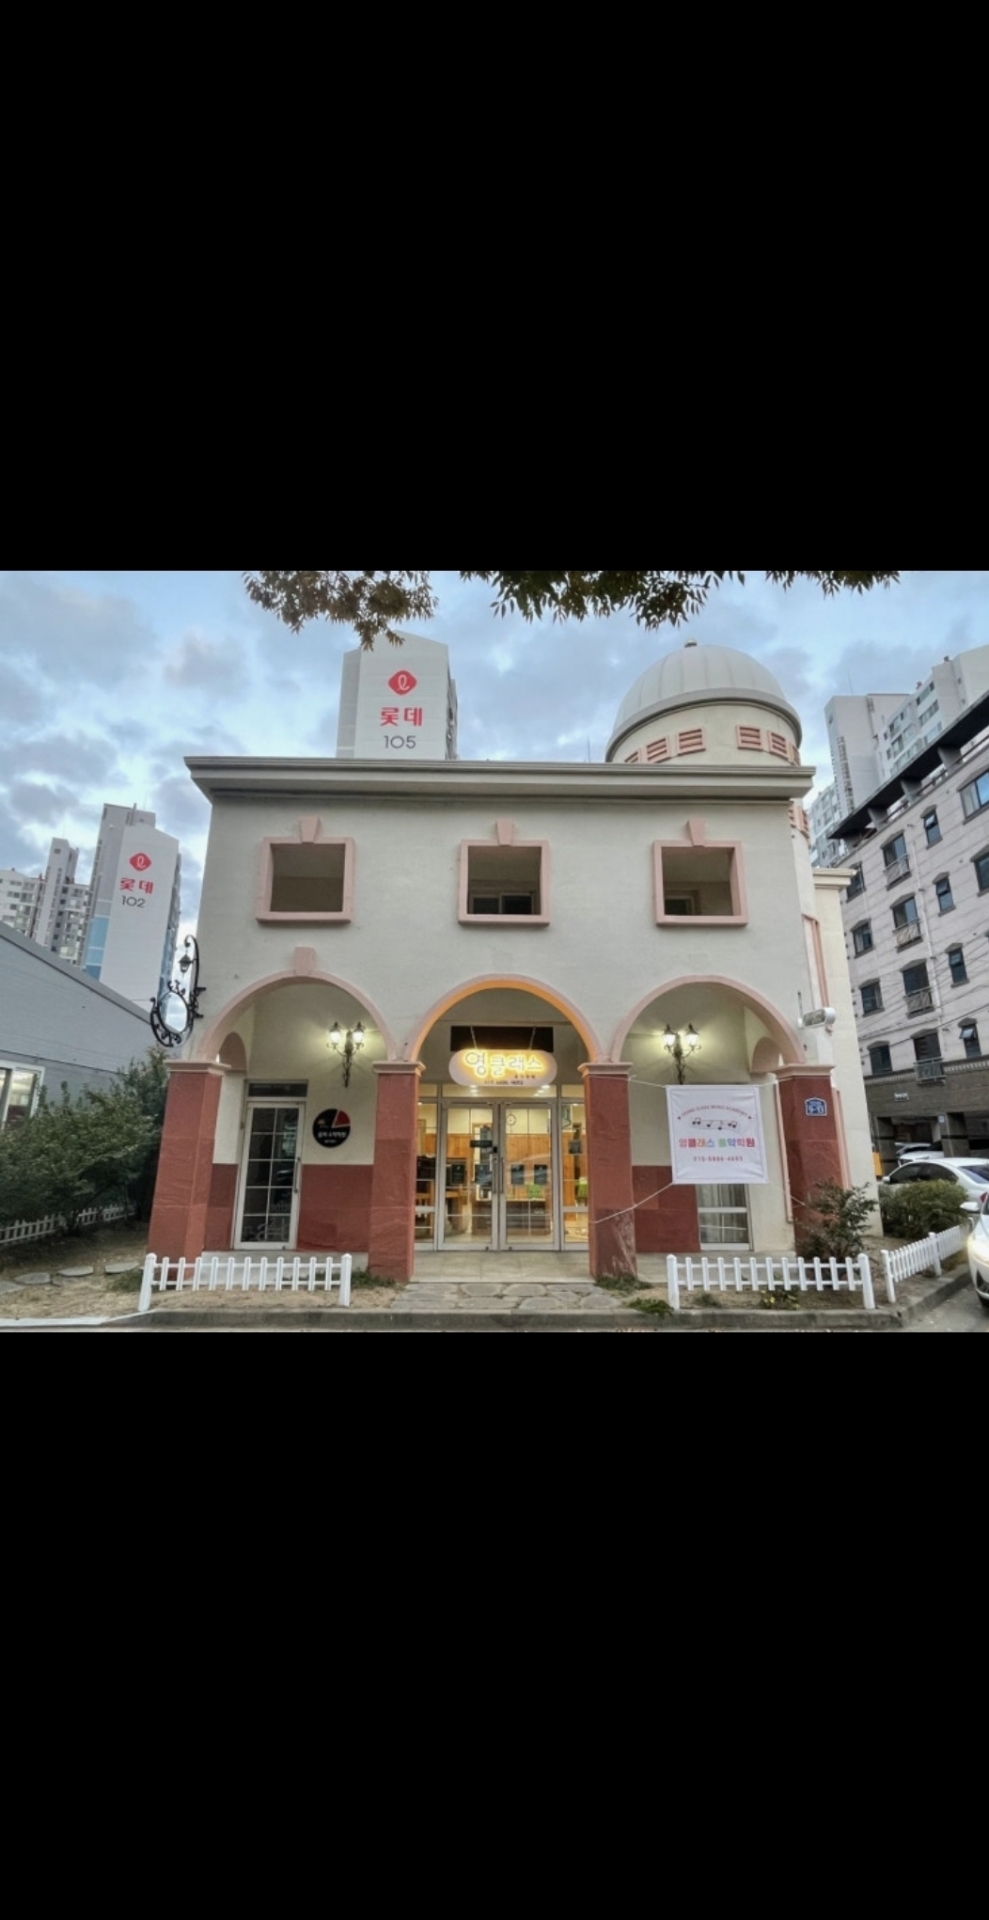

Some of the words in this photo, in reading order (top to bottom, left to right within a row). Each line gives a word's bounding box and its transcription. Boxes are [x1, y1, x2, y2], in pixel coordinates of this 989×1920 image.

[380, 707, 422, 727] 롯데
[383, 735, 417, 749] 105
[120, 877, 153, 894] 롯데
[122, 895, 146, 908] 102
[464, 1051, 542, 1077] 영클래스
[718, 1138, 755, 1148] 음악학원
